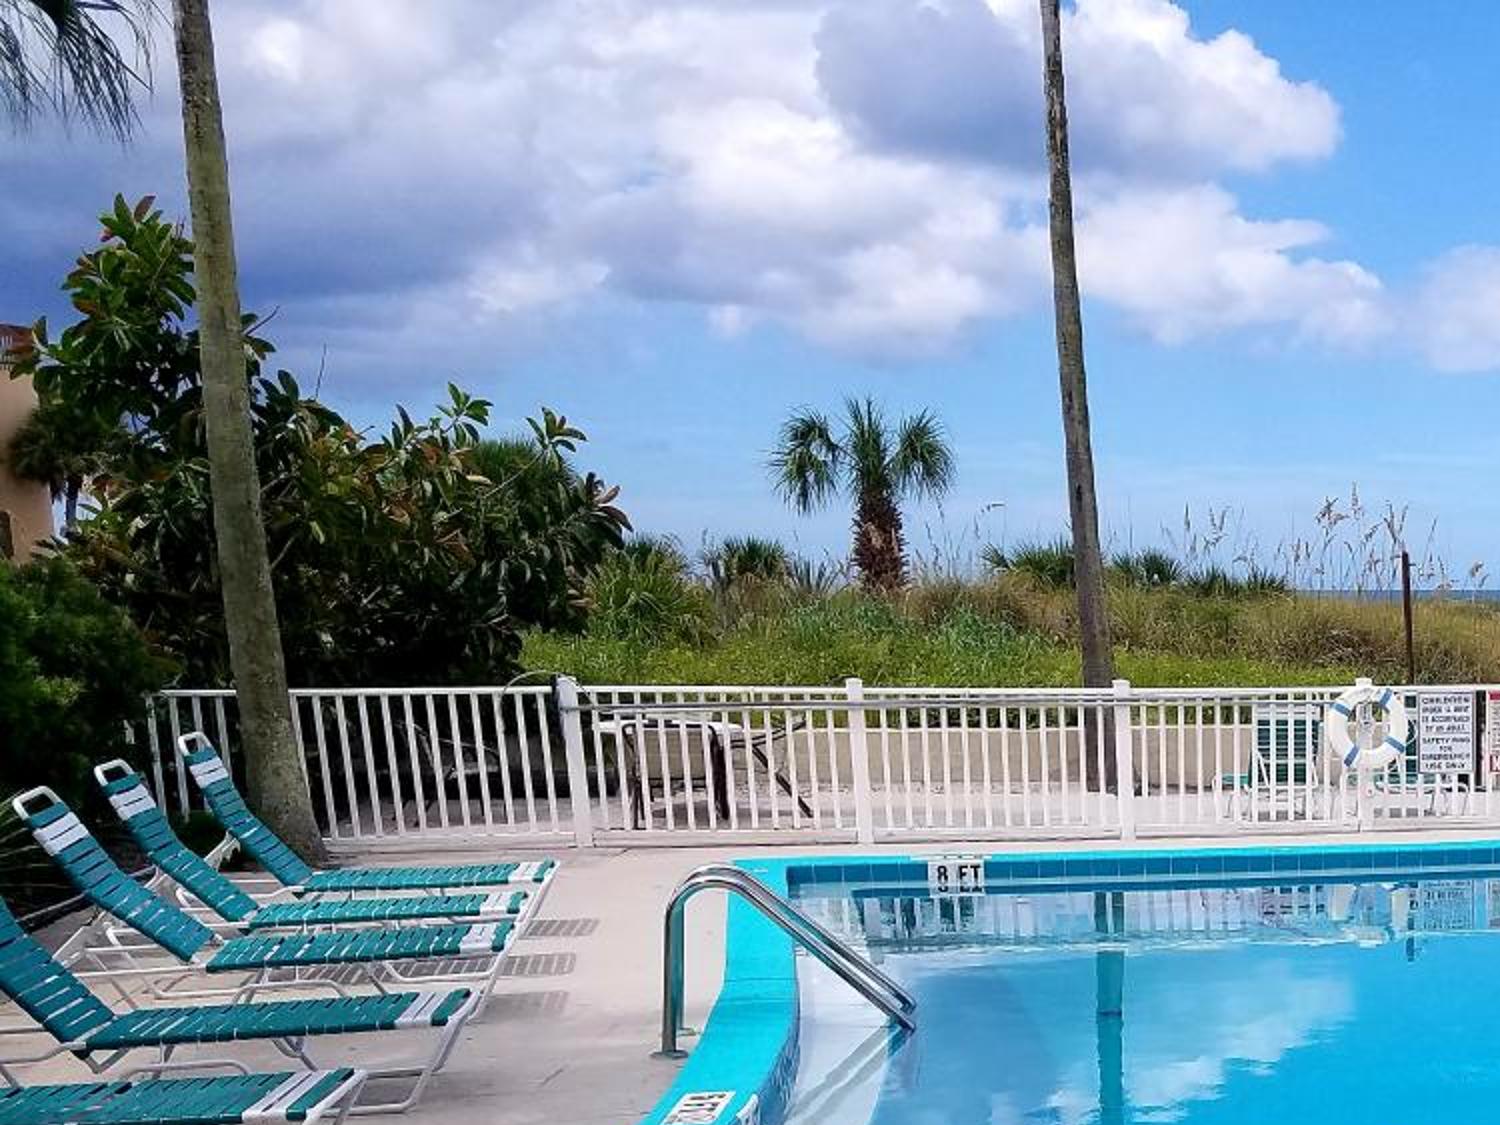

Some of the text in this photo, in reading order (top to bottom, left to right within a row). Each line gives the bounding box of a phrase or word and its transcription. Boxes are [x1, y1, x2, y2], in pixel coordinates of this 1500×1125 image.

[1421, 695, 1470, 705] CHILDREN
[1421, 737, 1451, 745] SAFETY
[1439, 745, 1452, 753] FOR
[1424, 761, 1465, 770] USE ONLY
[937, 864, 981, 884] 8 FT
